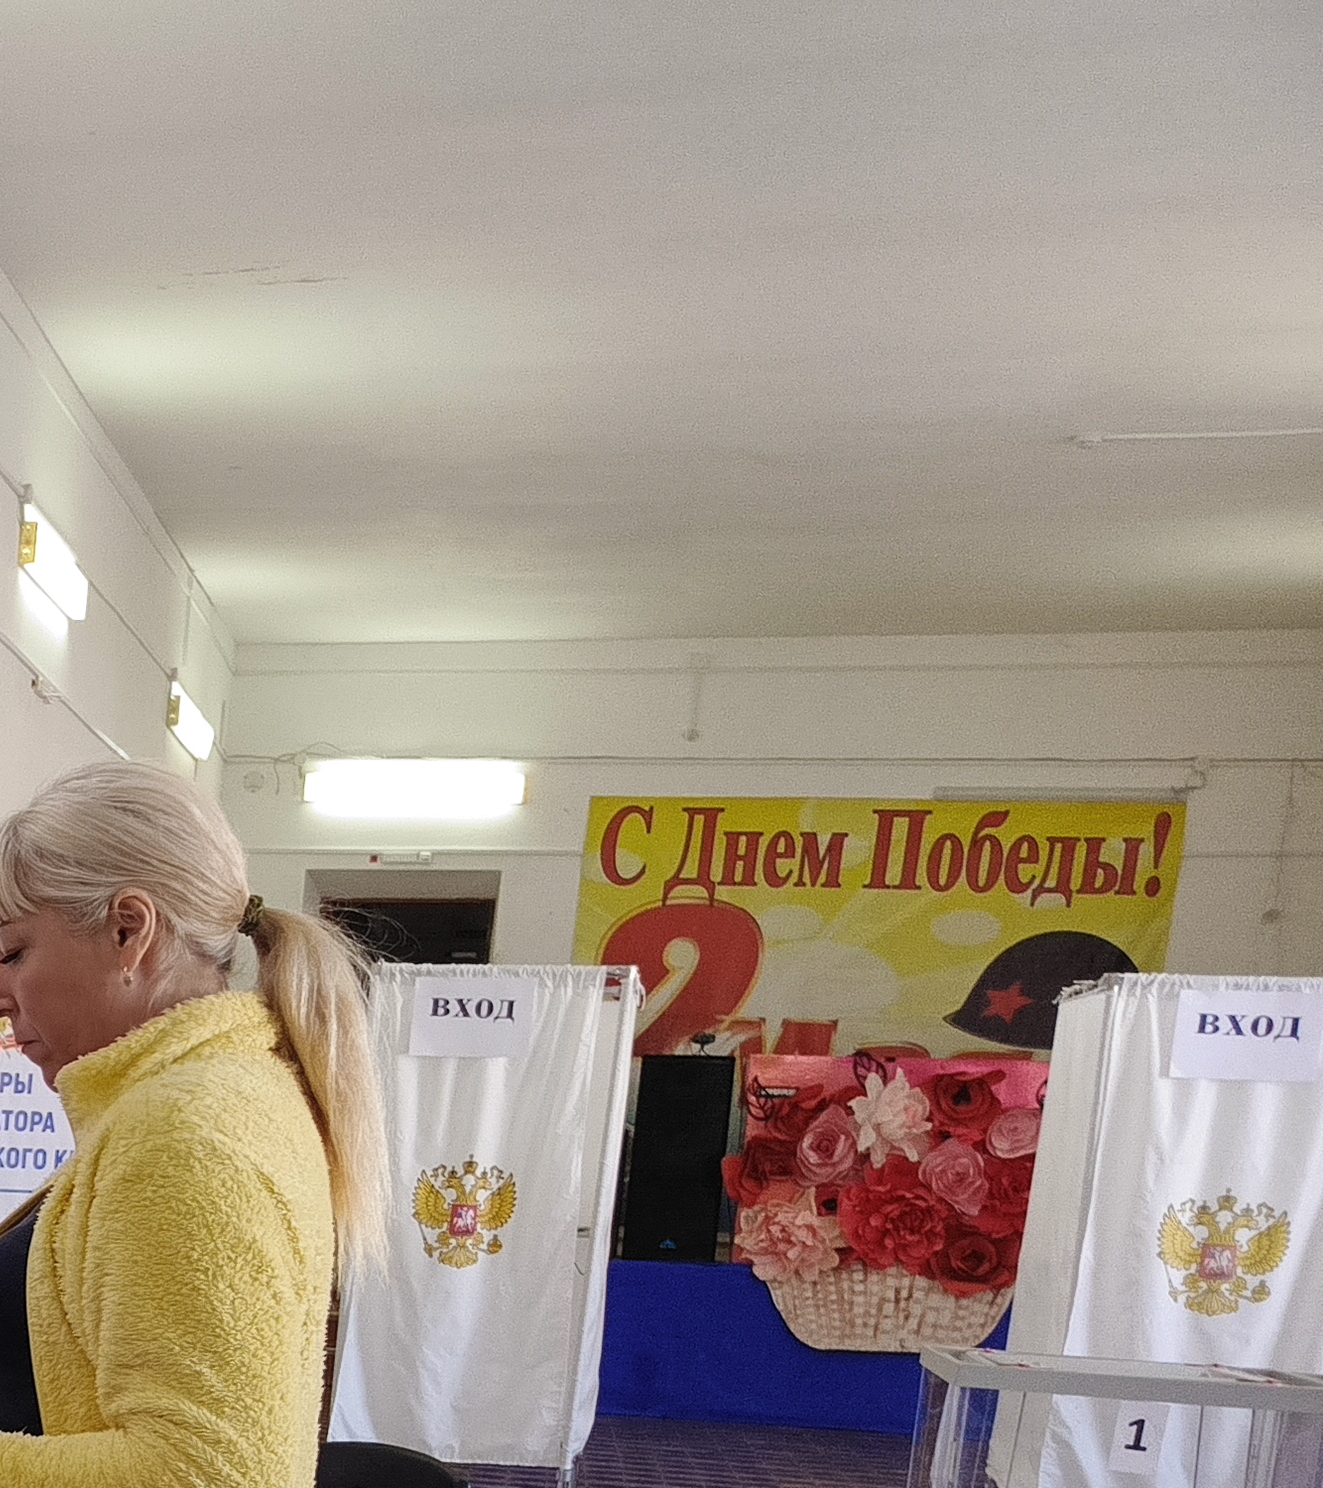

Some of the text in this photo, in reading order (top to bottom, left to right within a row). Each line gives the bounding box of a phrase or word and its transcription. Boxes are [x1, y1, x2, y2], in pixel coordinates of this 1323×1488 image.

[600, 804, 1172, 909] С Днем Победы!
[1124, 1418, 1148, 1452] 1
